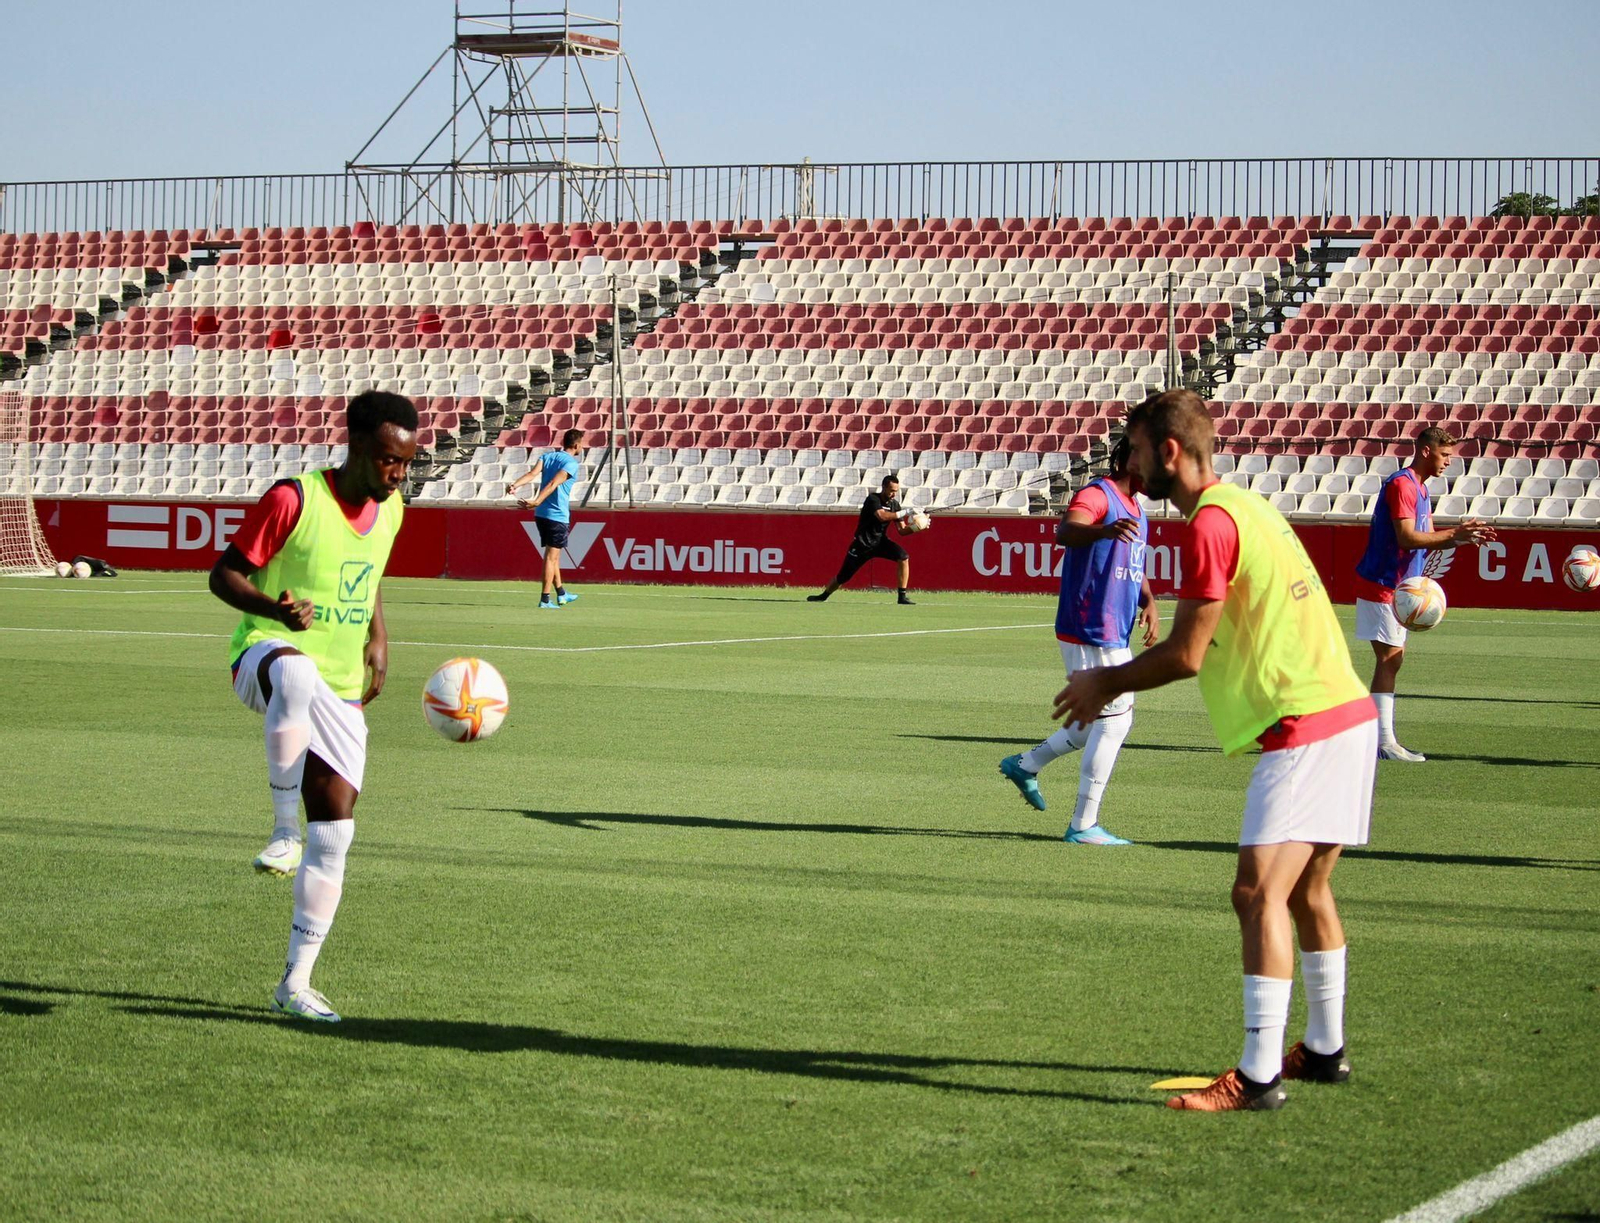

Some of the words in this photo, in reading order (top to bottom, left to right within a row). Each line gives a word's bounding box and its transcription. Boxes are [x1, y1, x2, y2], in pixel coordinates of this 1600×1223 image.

[603, 538, 784, 574] Valvoline
[972, 527, 1182, 589] Cruzmp
[1115, 566, 1144, 583] GIVO
